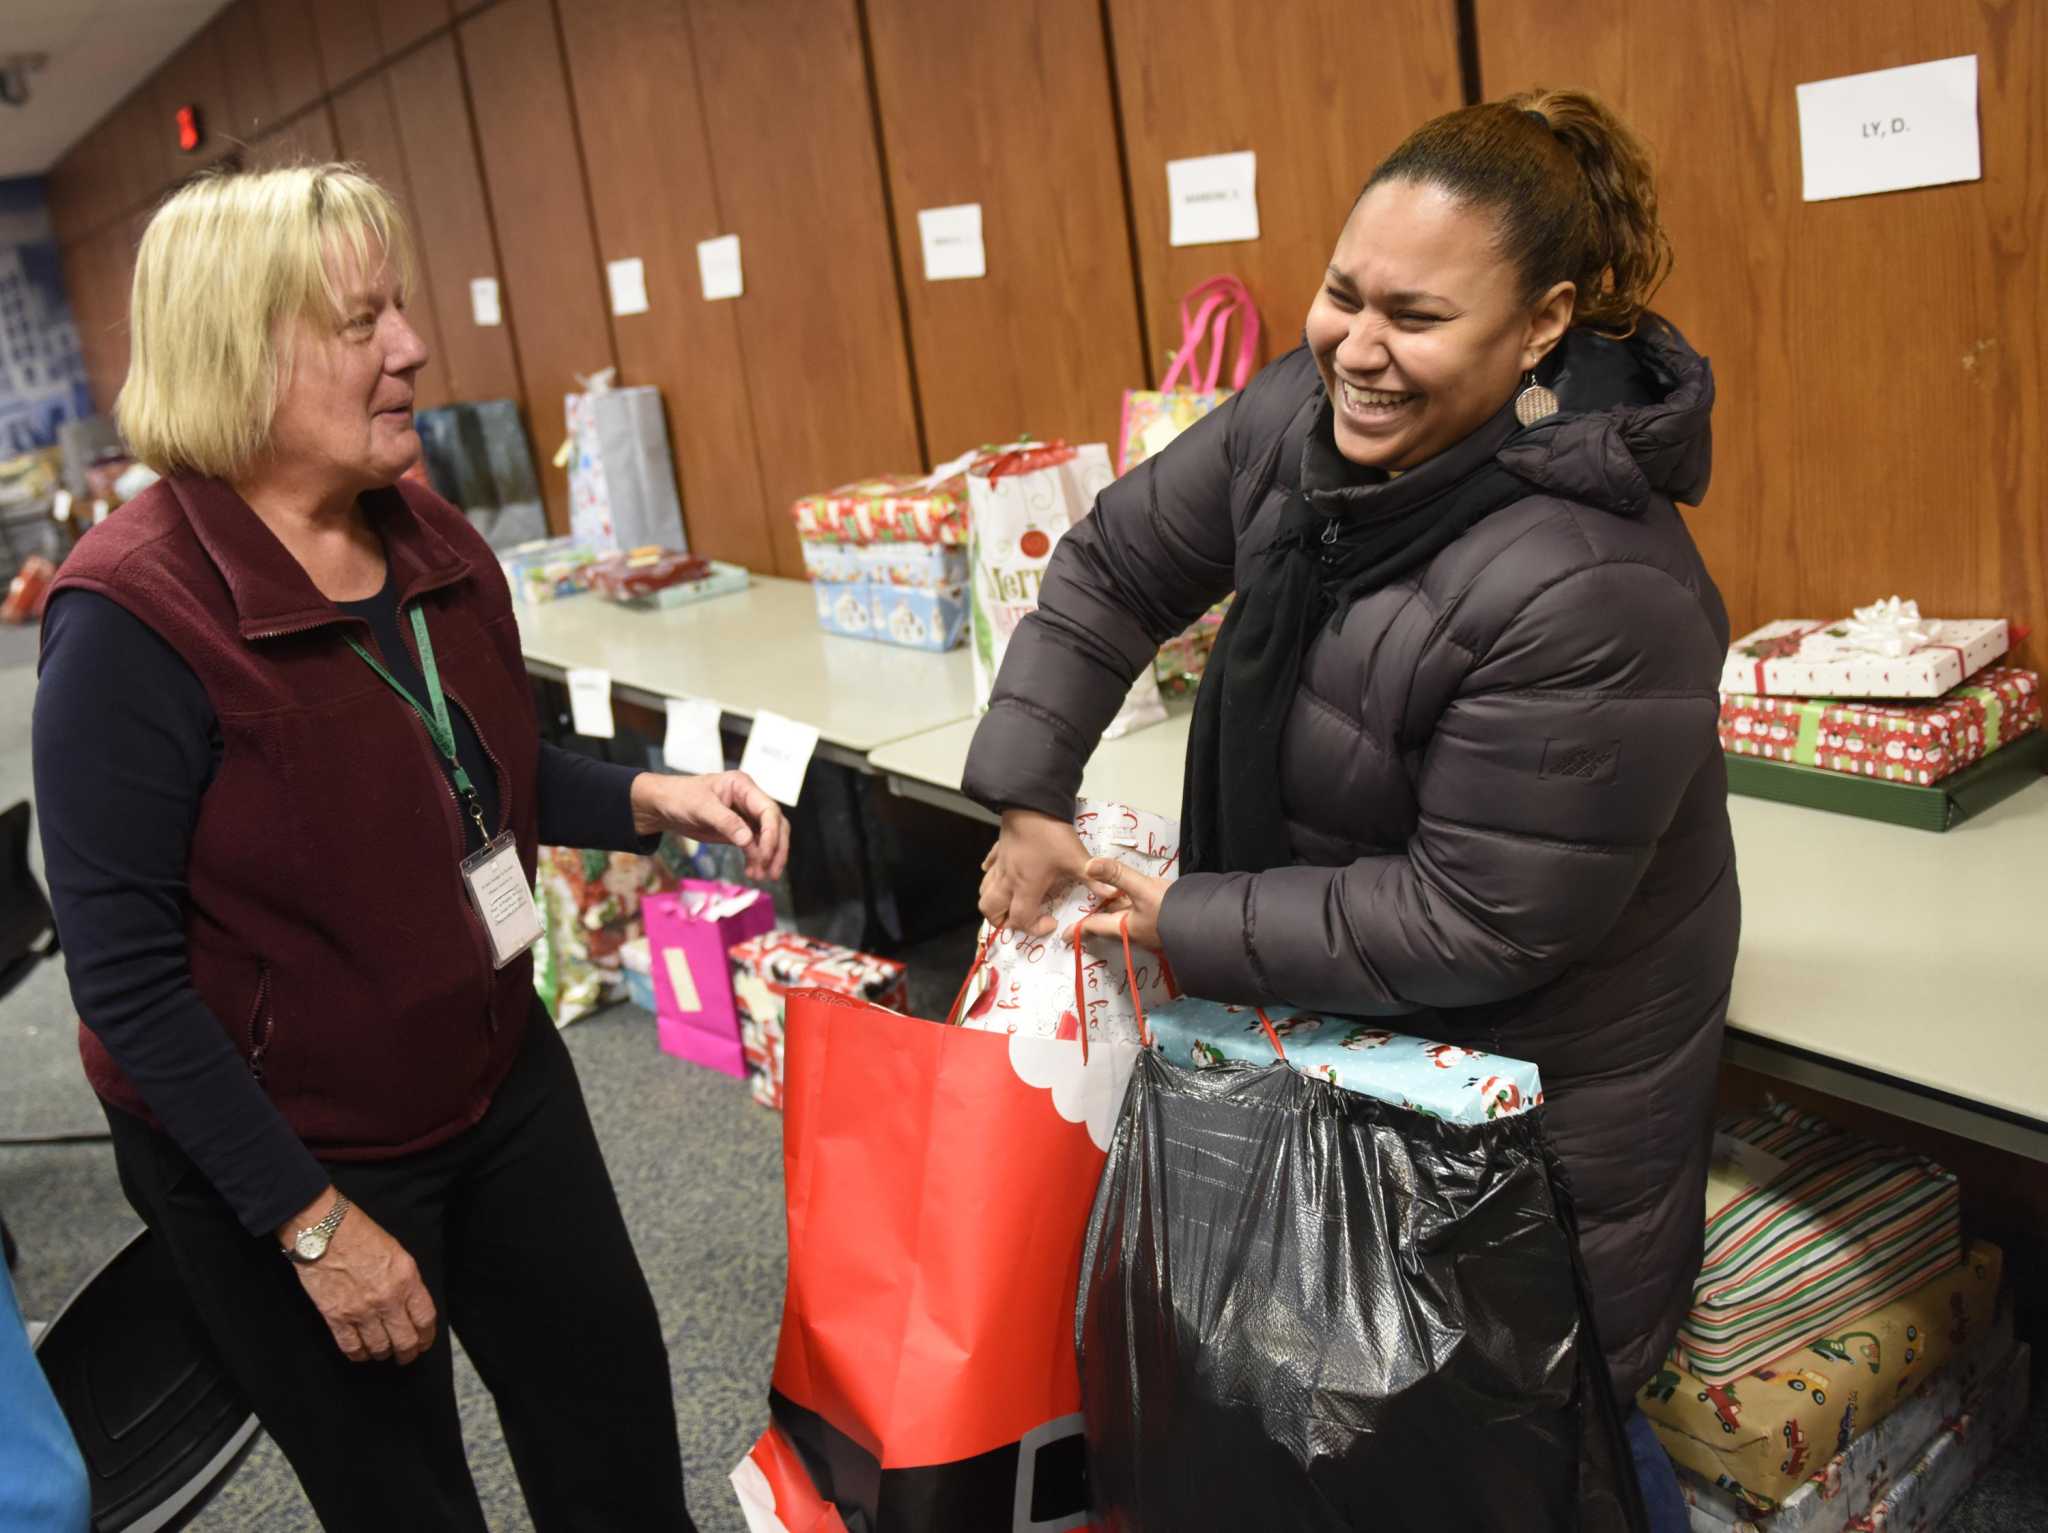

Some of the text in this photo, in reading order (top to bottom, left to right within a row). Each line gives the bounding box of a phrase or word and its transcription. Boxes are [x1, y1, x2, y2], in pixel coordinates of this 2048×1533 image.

[1862, 117, 1911, 139] LY, D.
[987, 566, 1044, 602] Merr
[997, 982, 1021, 1009] ho
[1084, 960, 1110, 1029] ho ho
